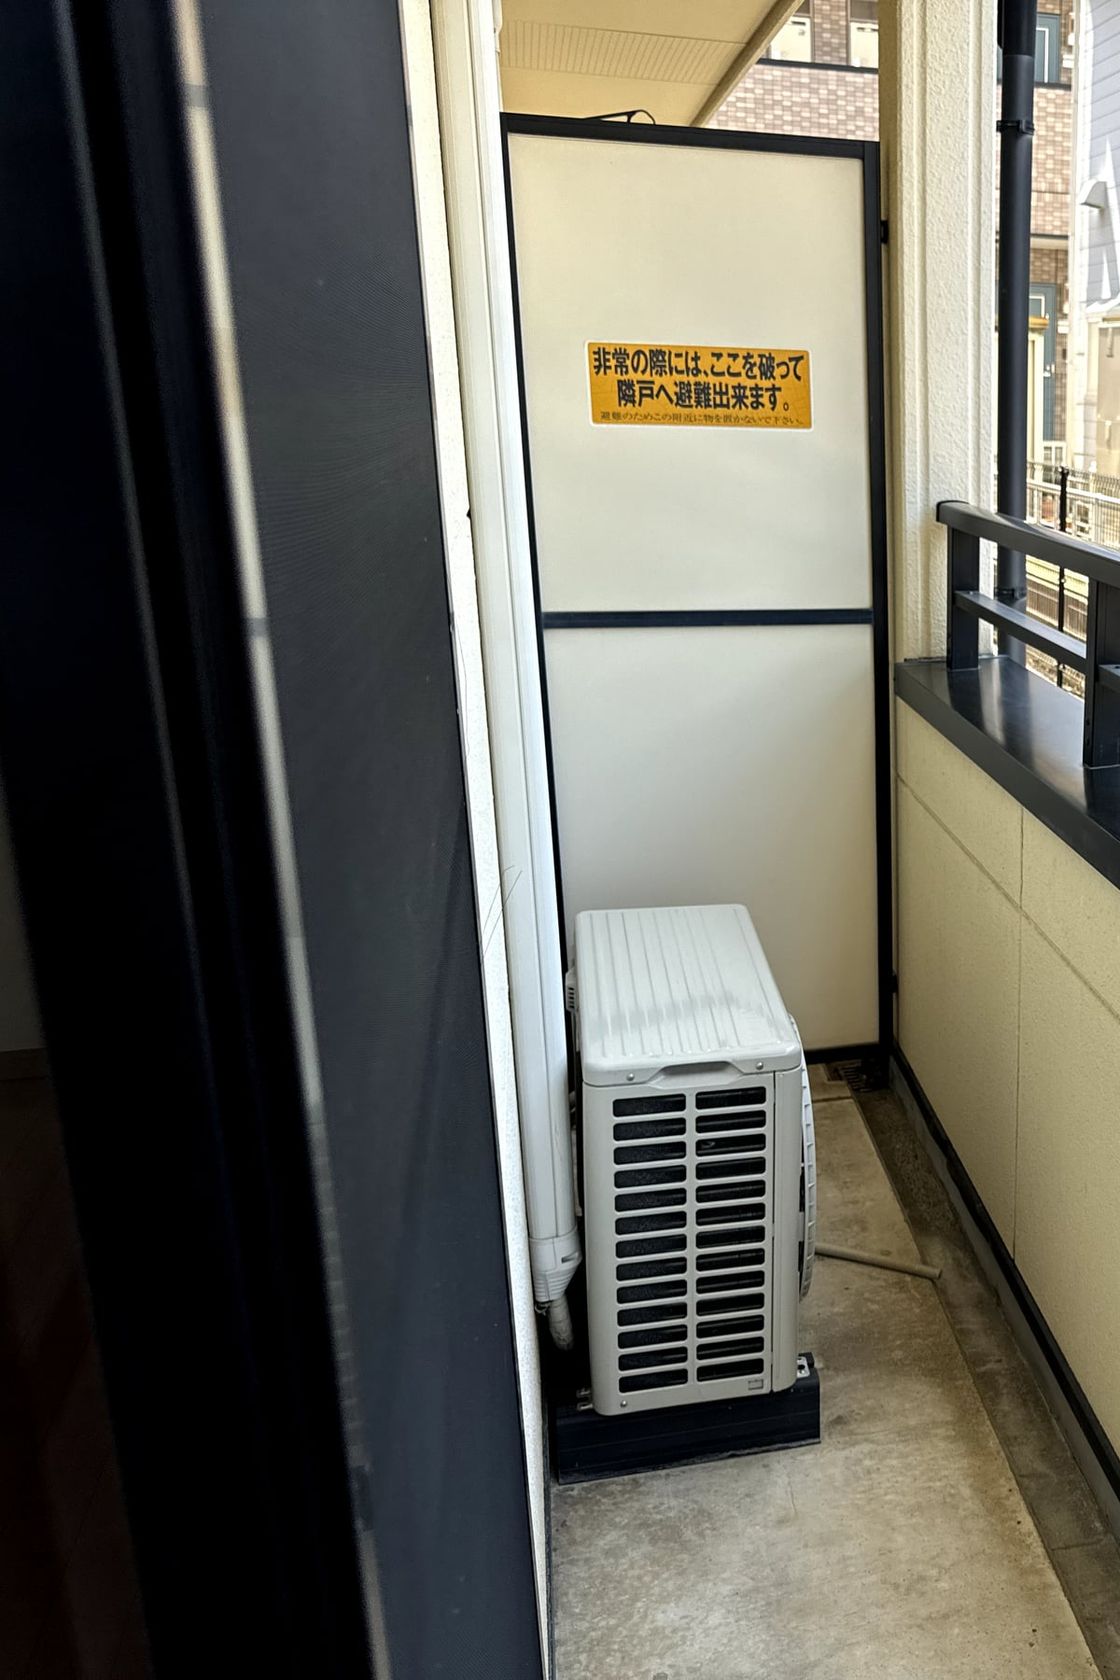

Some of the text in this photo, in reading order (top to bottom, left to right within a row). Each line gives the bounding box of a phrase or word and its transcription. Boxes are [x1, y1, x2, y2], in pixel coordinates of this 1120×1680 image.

[593, 347, 804, 382] 非常の際には、ここを破って
[617, 378, 789, 411] 隣戸へ避難出来ます。
